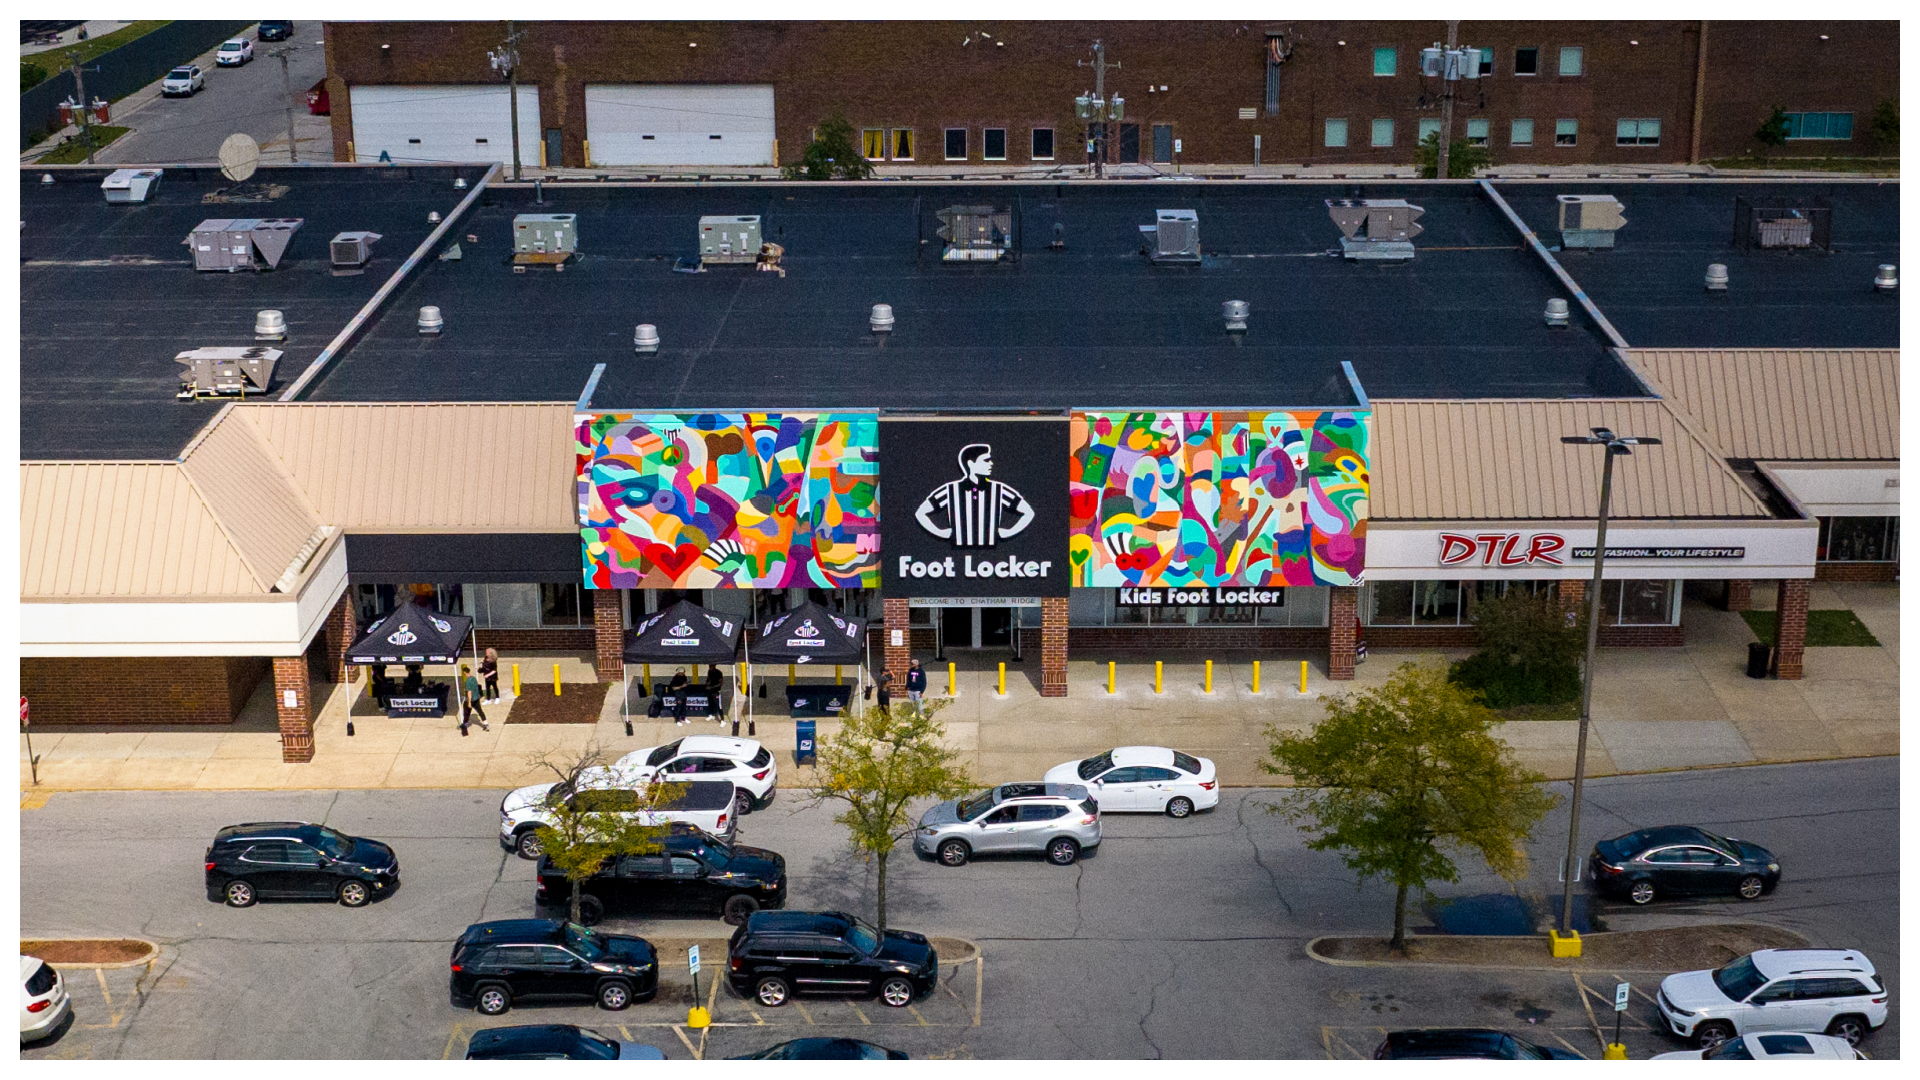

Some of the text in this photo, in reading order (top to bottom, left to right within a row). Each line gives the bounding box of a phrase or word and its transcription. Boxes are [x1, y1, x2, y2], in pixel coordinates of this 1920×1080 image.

[1439, 532, 1566, 566] DTLR
[1574, 549, 1596, 557] YOU
[899, 555, 1052, 578] Foot Locker
[914, 597, 949, 605] WELCOME
[955, 597, 965, 605] TO
[970, 597, 1007, 605] CHATHAM
[1120, 588, 1280, 604] Kids Foot Locker
